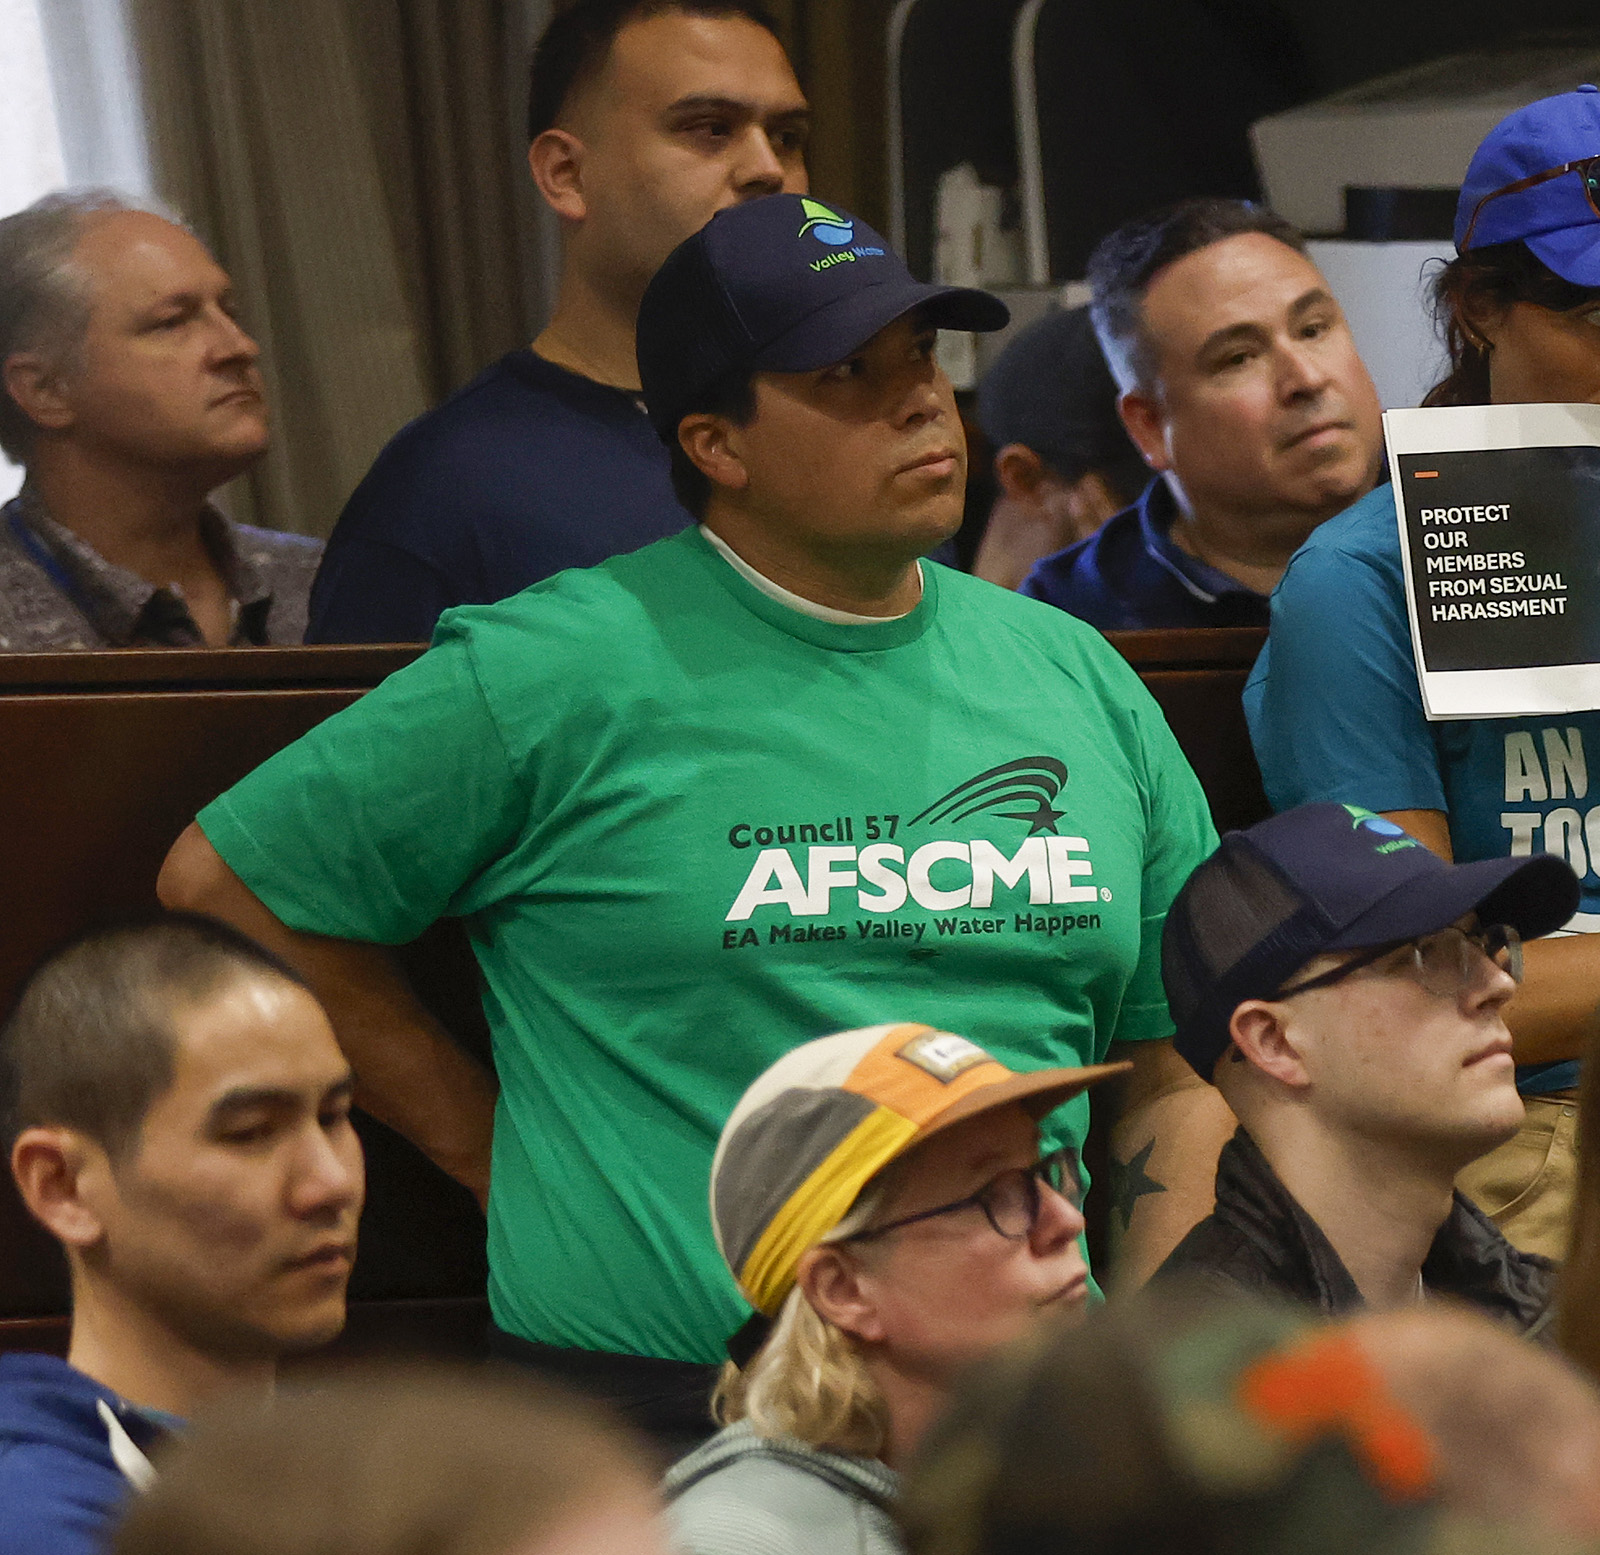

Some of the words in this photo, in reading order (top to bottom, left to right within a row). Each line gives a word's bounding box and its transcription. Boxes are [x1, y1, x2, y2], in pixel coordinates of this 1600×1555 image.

[809, 251, 856, 272] Valley
[1420, 504, 1511, 526] PROTECT
[1423, 531, 1469, 549] OUR
[1426, 552, 1525, 574] MEMBERS
[1429, 578, 1488, 598] FROM
[1490, 573, 1568, 595] SEXUAL
[1431, 598, 1568, 622] HARASSMENT
[1504, 727, 1588, 802] AN
[728, 816, 854, 849] Council
[865, 814, 900, 840] 57
[724, 835, 1099, 921] AFSCME
[722, 929, 760, 950] EA
[769, 923, 848, 945] Makes
[856, 919, 927, 944] Valley
[933, 916, 1006, 936] Water
[1014, 913, 1101, 935] Happen
